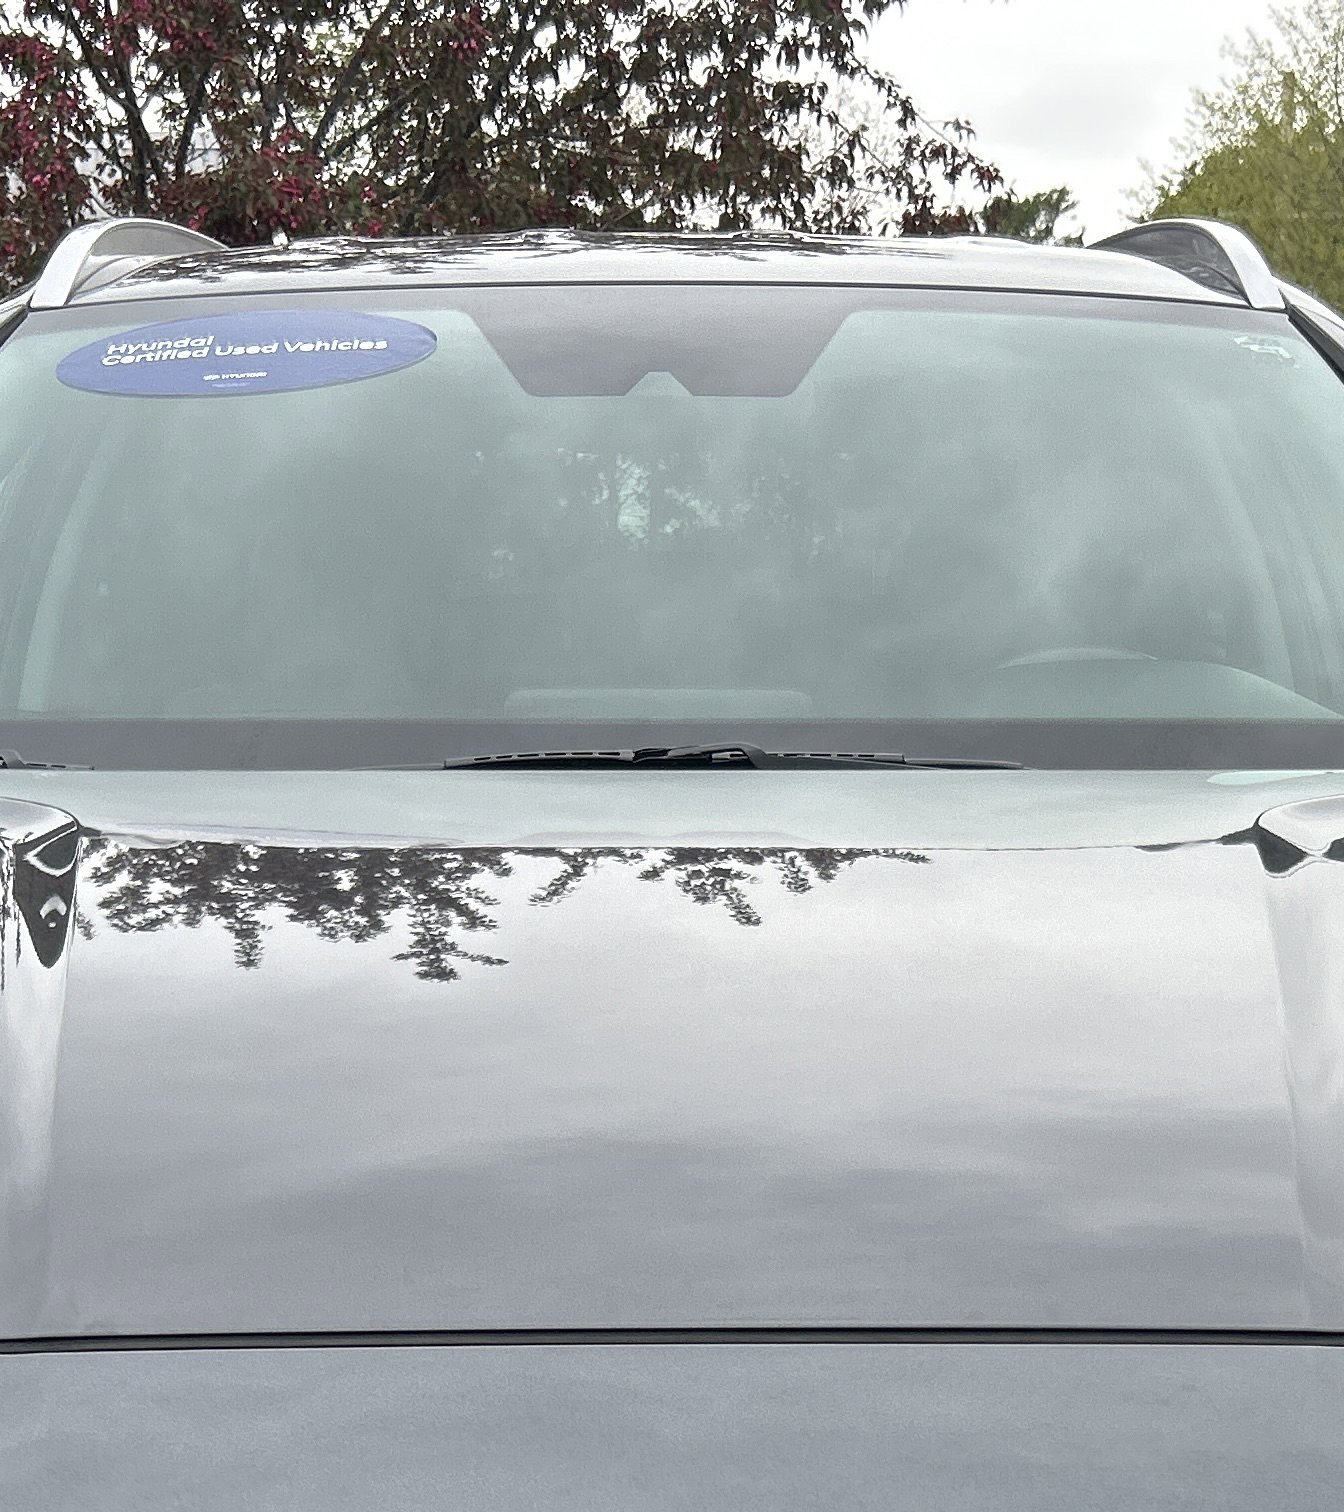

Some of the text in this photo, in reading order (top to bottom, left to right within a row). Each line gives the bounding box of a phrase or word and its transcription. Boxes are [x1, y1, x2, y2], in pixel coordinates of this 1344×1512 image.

[101, 338, 389, 367] Certified Used Vehicles
[106, 335, 215, 356] Hyundai
